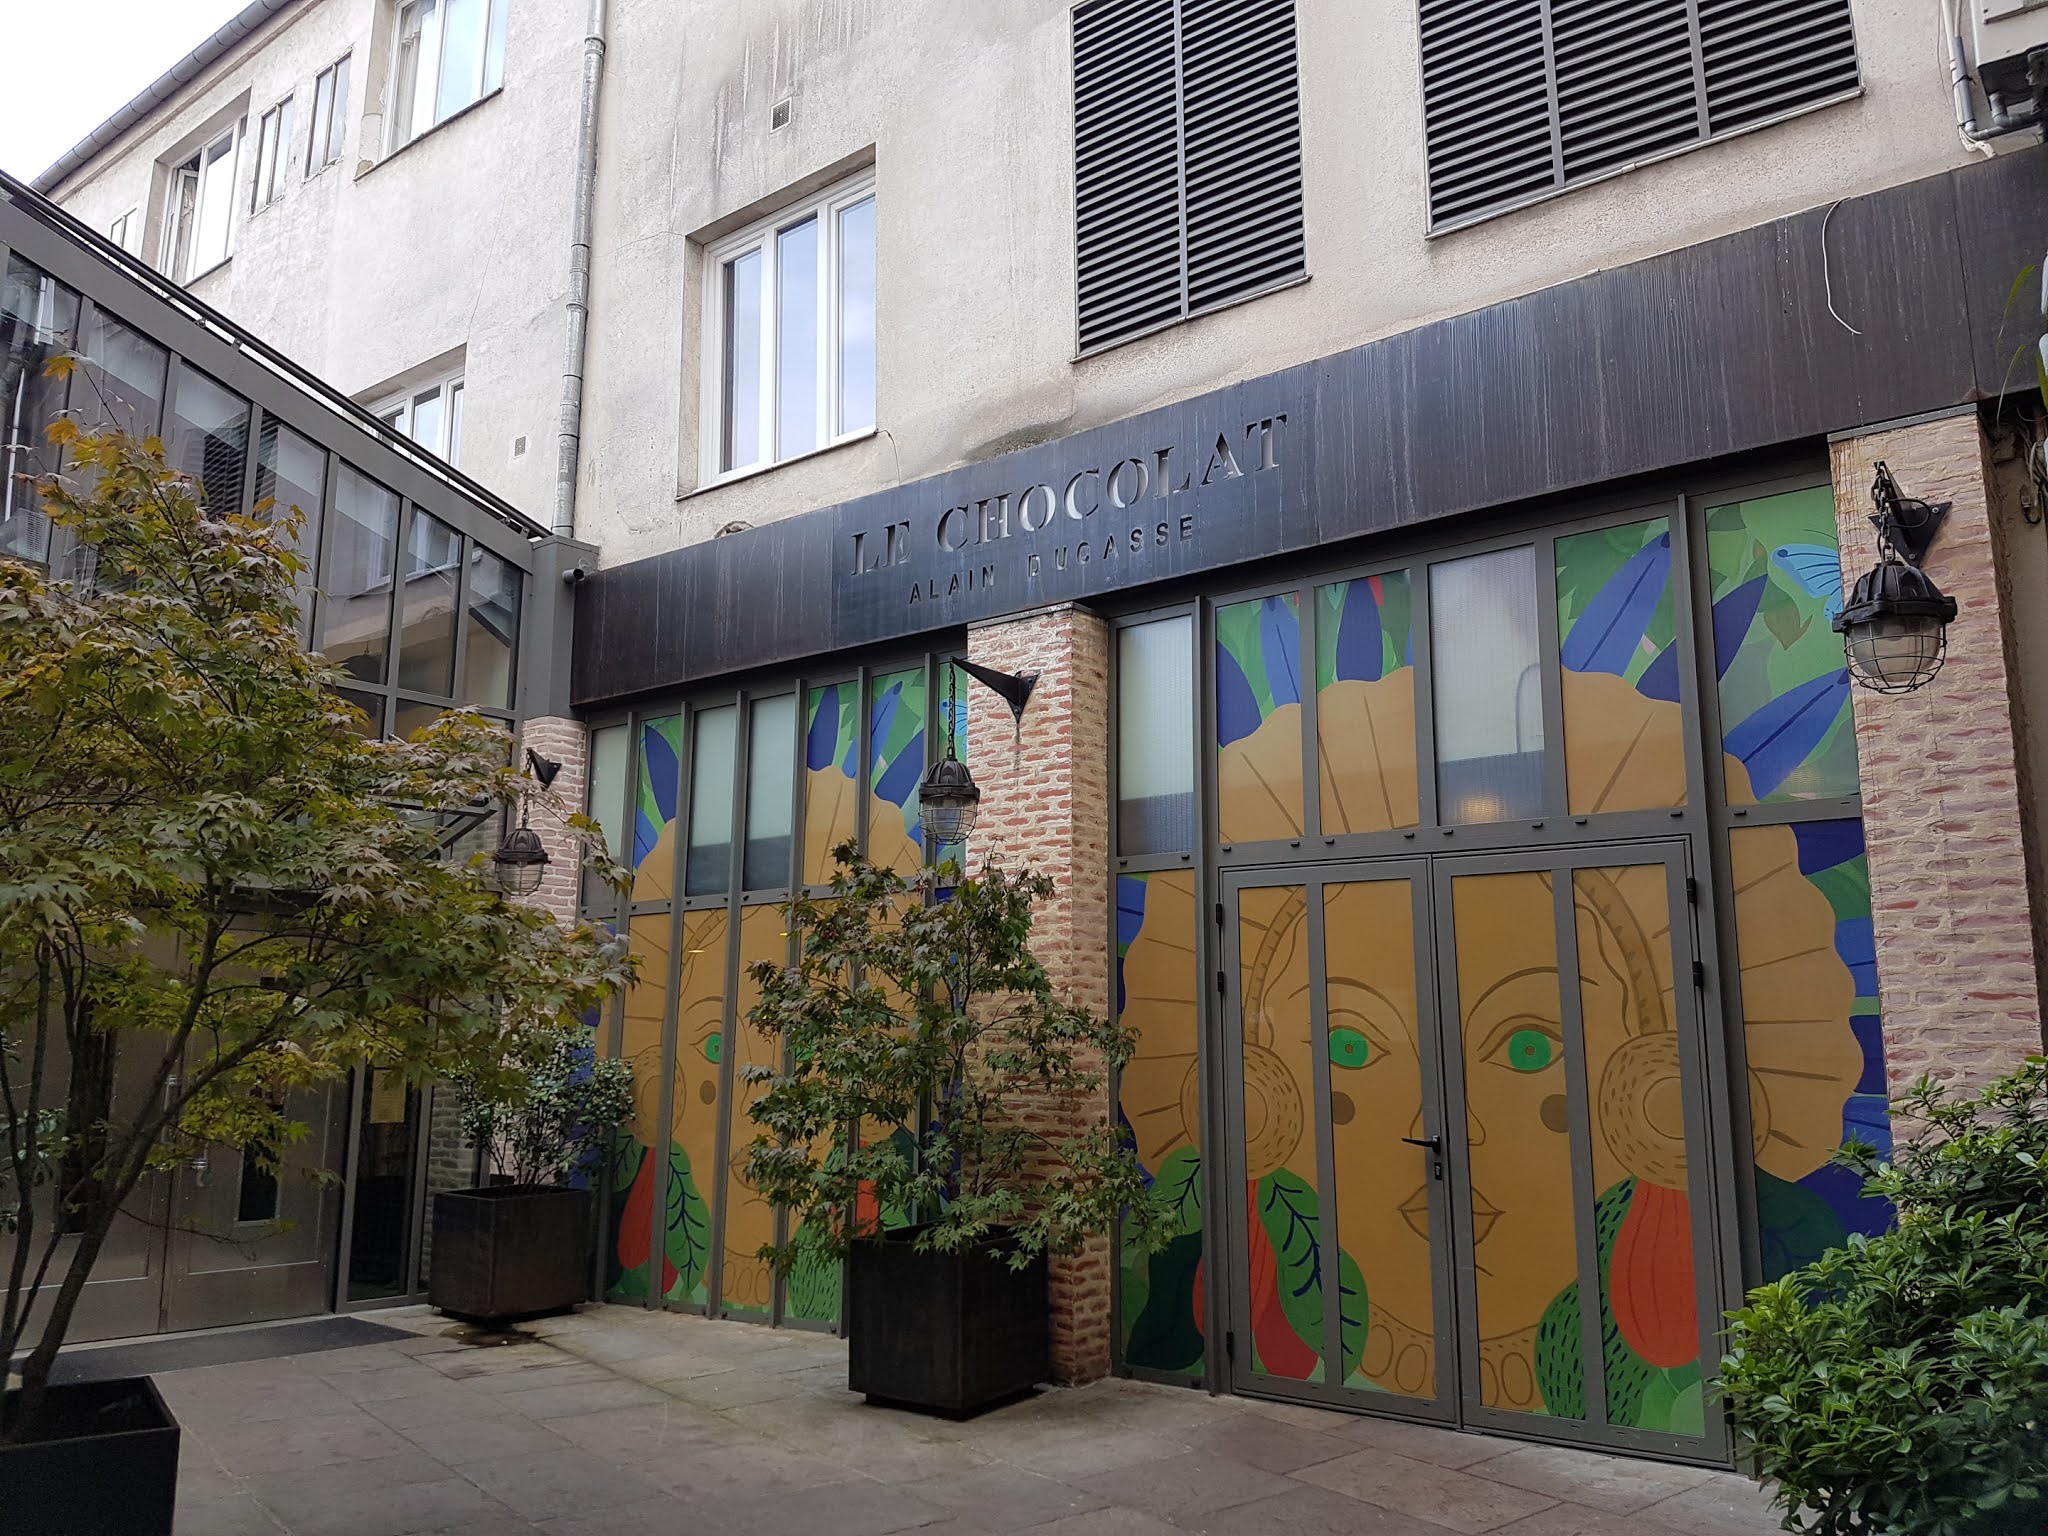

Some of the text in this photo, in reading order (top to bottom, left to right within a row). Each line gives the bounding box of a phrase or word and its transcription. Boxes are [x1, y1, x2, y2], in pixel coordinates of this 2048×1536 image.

[850, 413, 1287, 577] LE CHOCOLAT
[909, 515, 1193, 605] ALAIN DUCASSE
